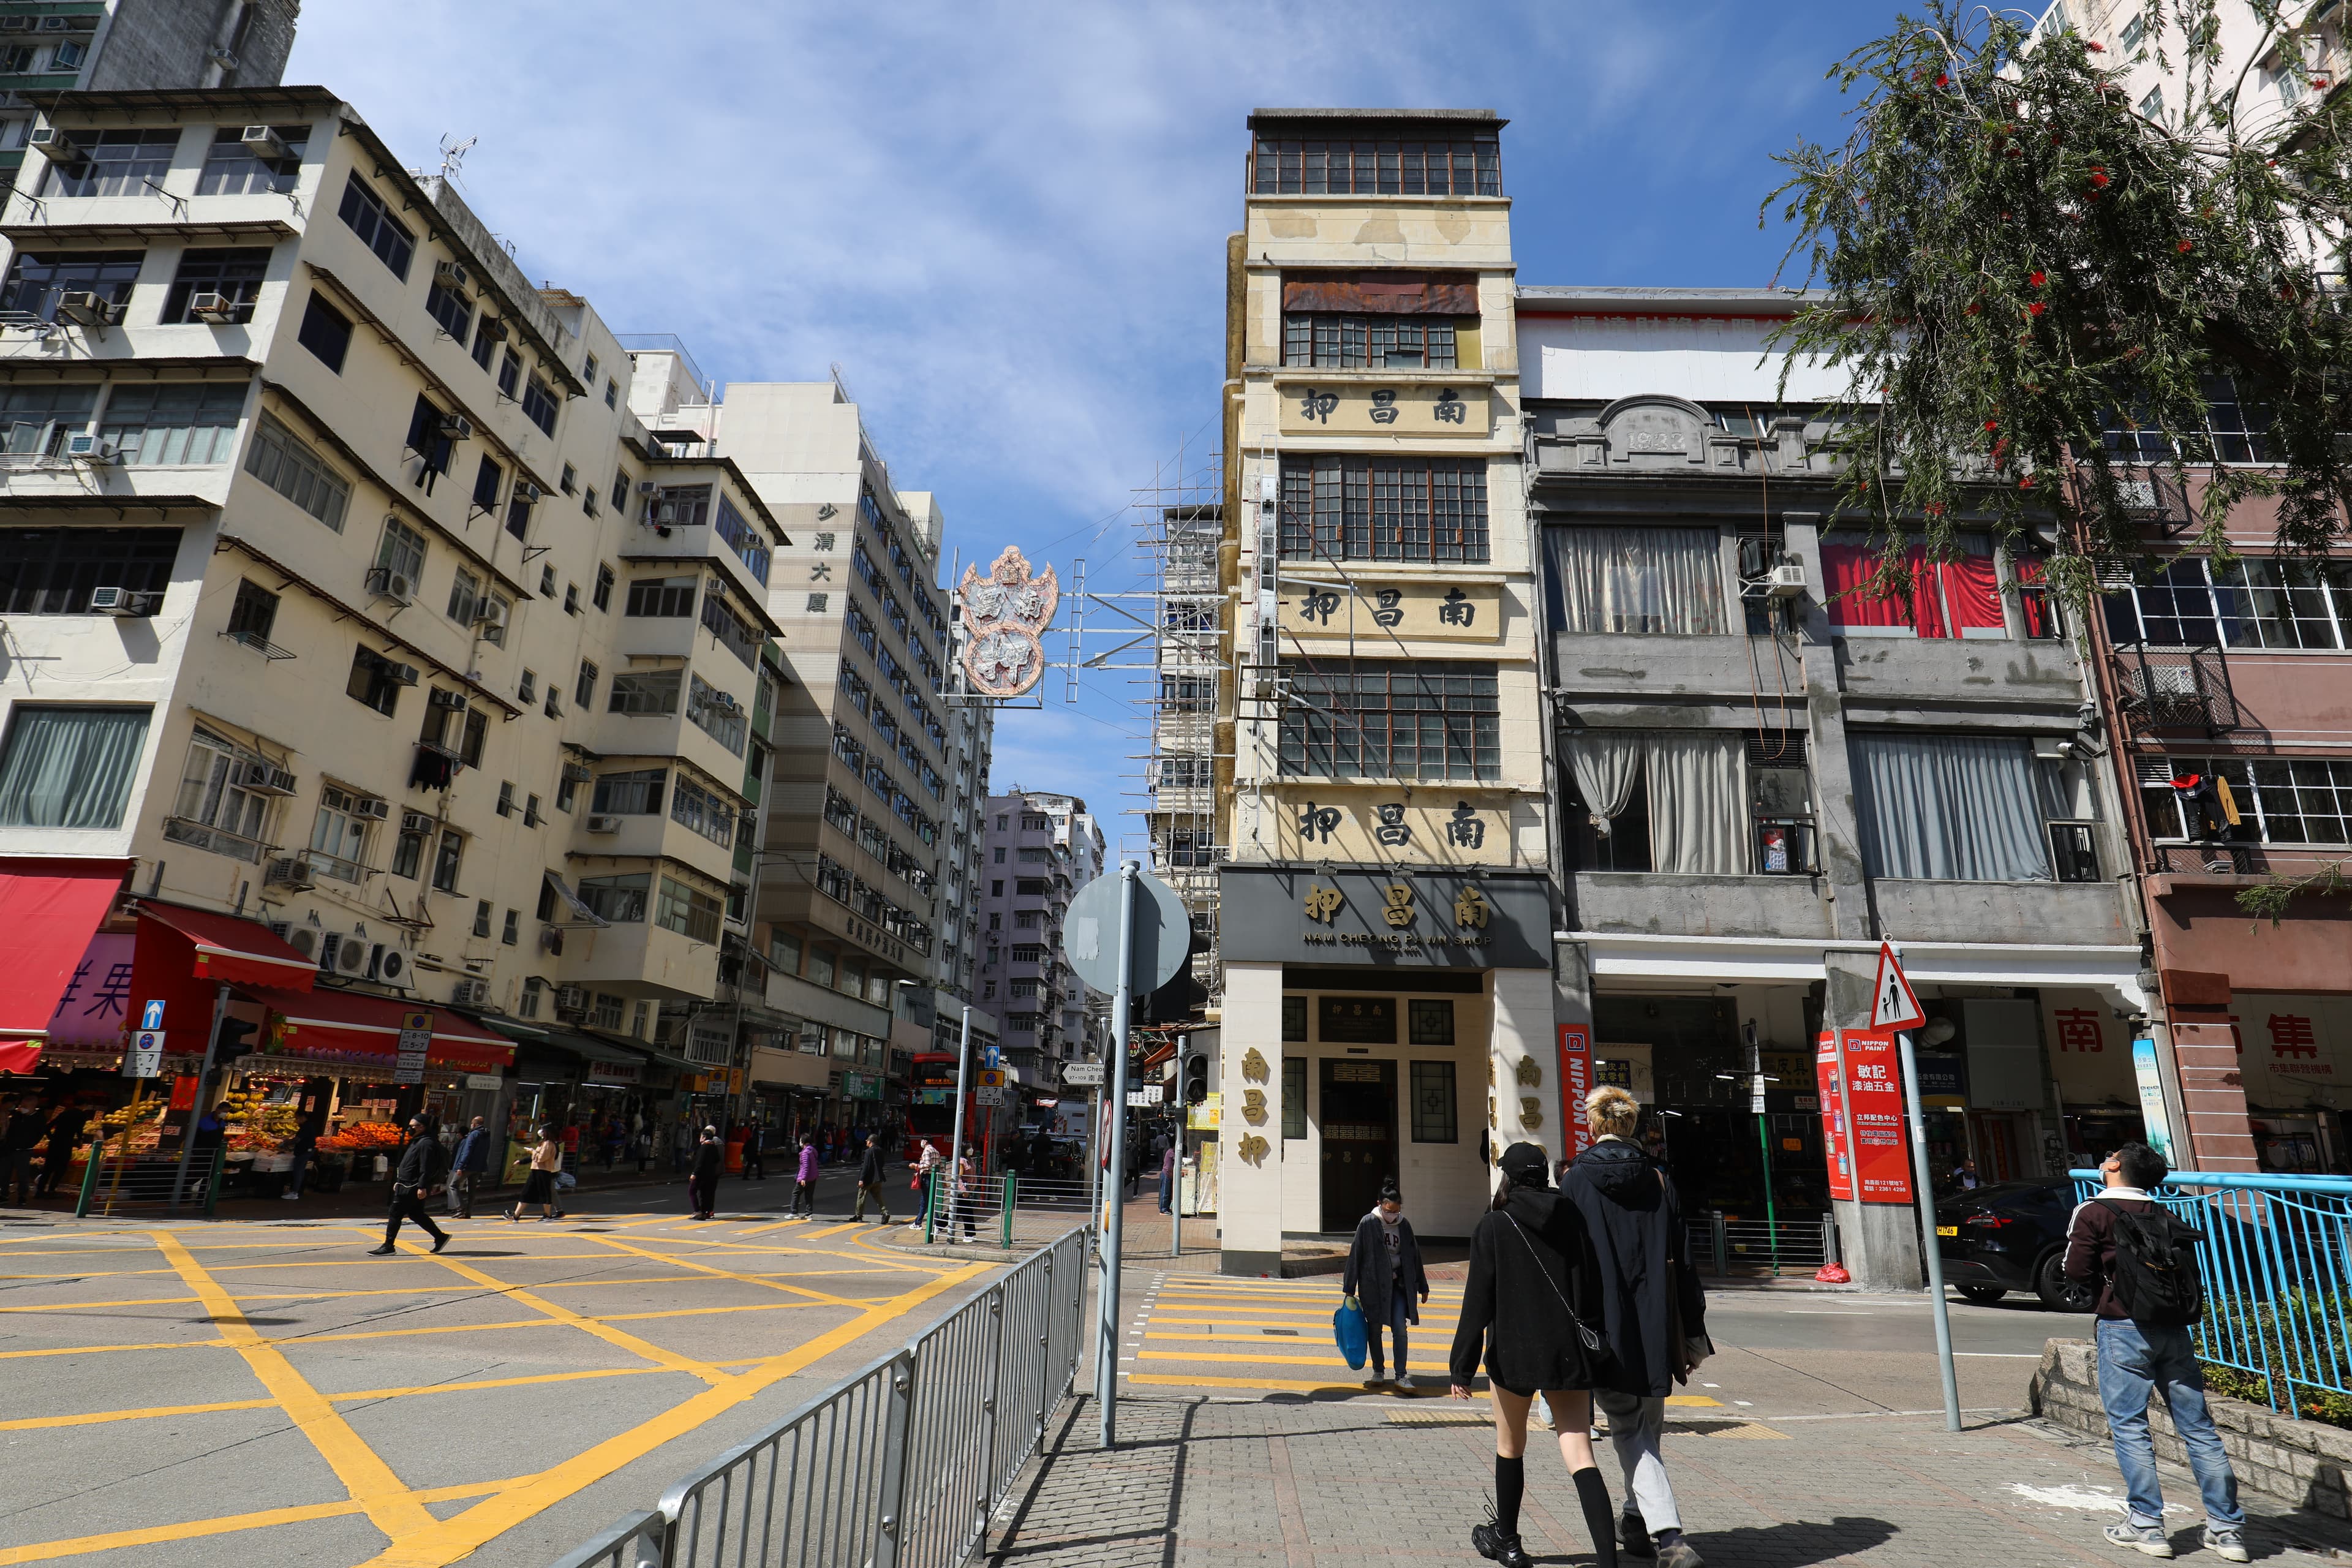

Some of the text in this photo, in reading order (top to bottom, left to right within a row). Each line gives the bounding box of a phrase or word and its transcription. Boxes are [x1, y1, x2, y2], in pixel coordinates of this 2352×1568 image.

[806, 503, 838, 612] 少清大廈
[1303, 933, 1493, 944] NAM CHEONG PAWN SHOP
[2054, 1008, 2103, 1052] 南
[148, 1054, 154, 1063] 7
[145, 1068, 151, 1076] 7
[1858, 1065, 1887, 1079] 敏記
[1852, 1080, 1894, 1092] 漆油五金
[1237, 1047, 1267, 1166] 南昌押
[1516, 1055, 1548, 1155] 南昌
[1570, 1058, 1589, 1155] NIPPON PA
[1385, 1233, 1399, 1247] AP
